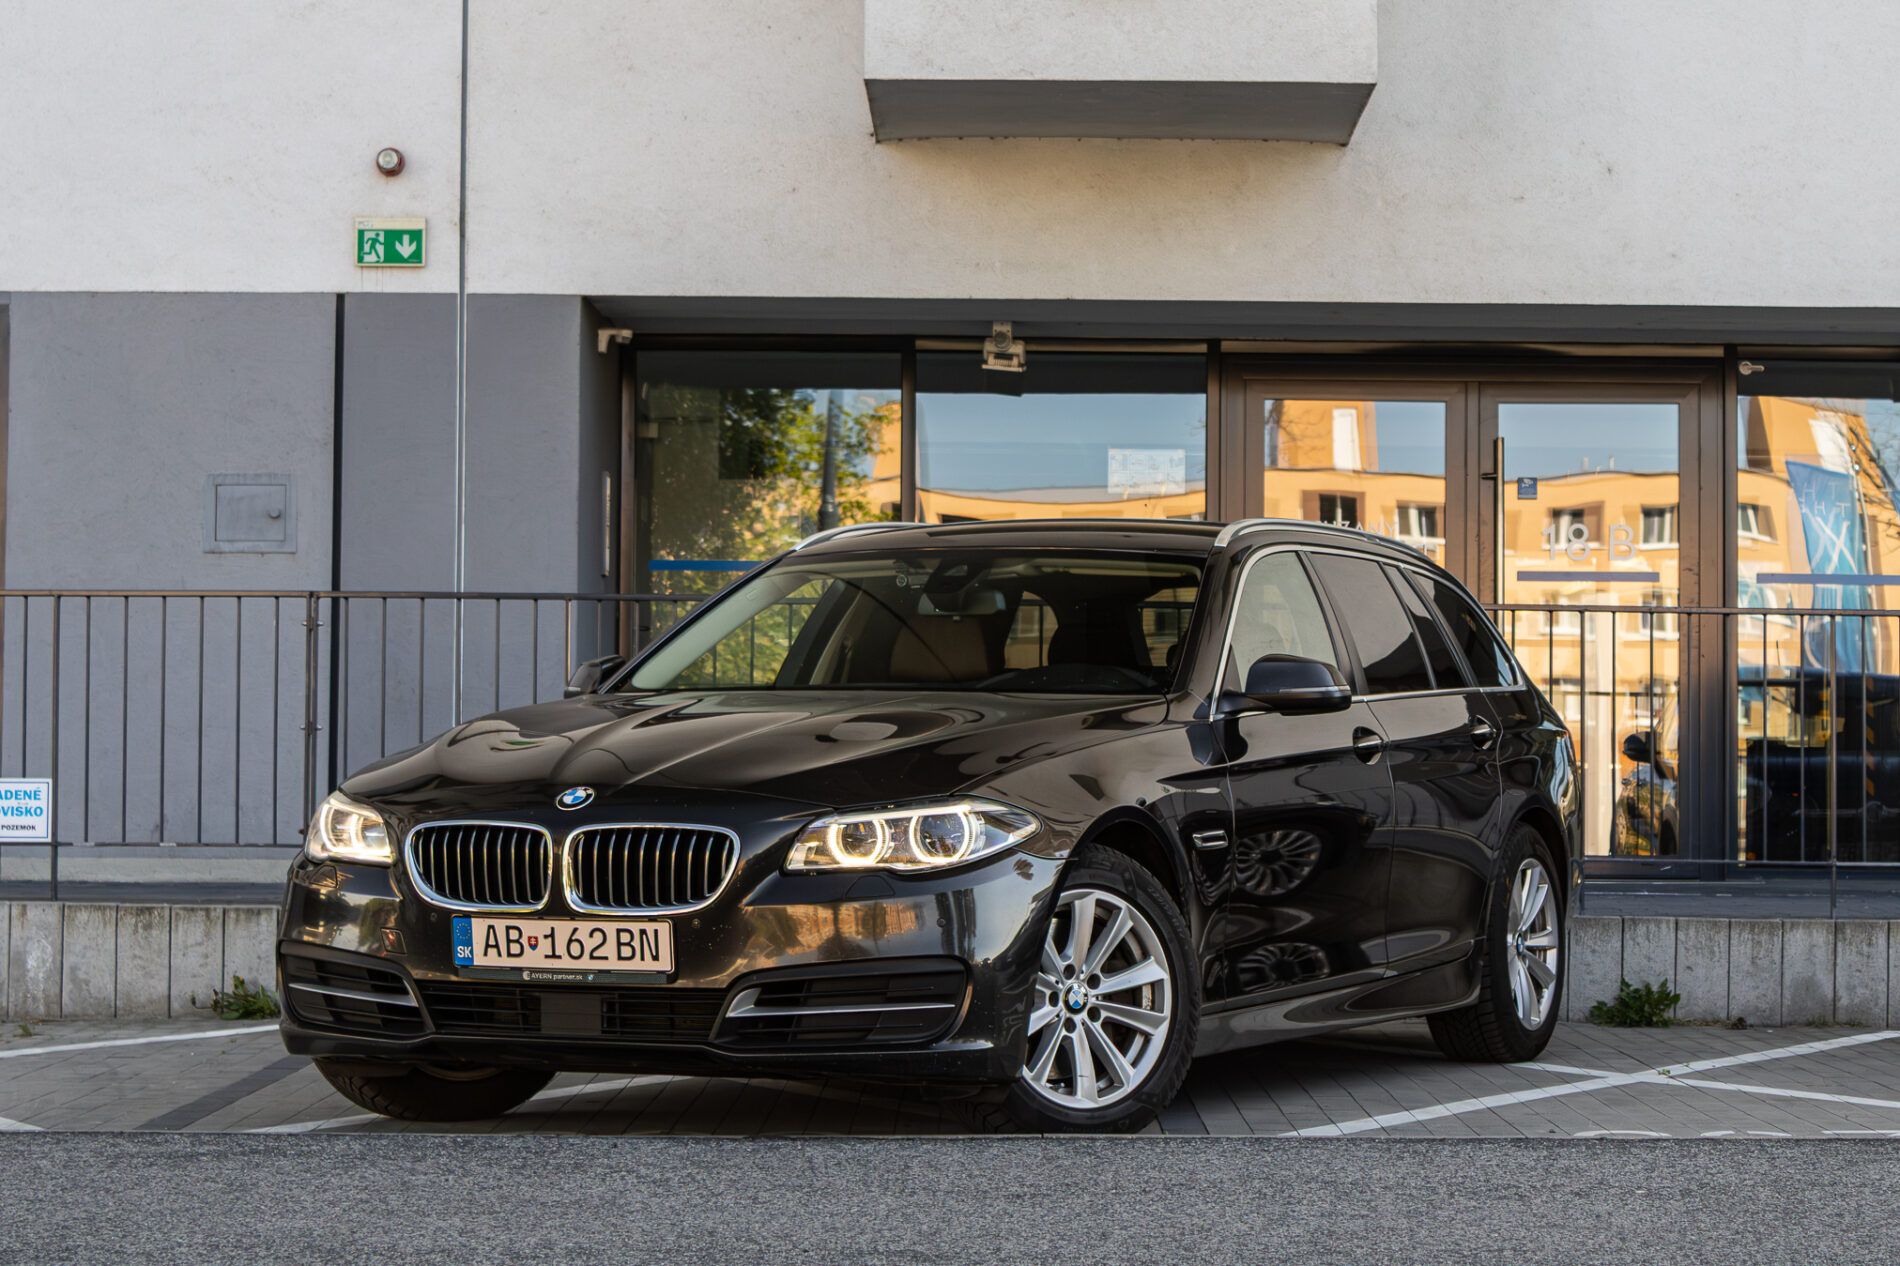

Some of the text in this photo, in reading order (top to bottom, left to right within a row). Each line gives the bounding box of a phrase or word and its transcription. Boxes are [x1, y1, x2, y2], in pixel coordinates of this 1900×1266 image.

[1541, 523, 1636, 561] 18 B
[0, 806, 43, 817] VISKO
[457, 946, 472, 958] SK
